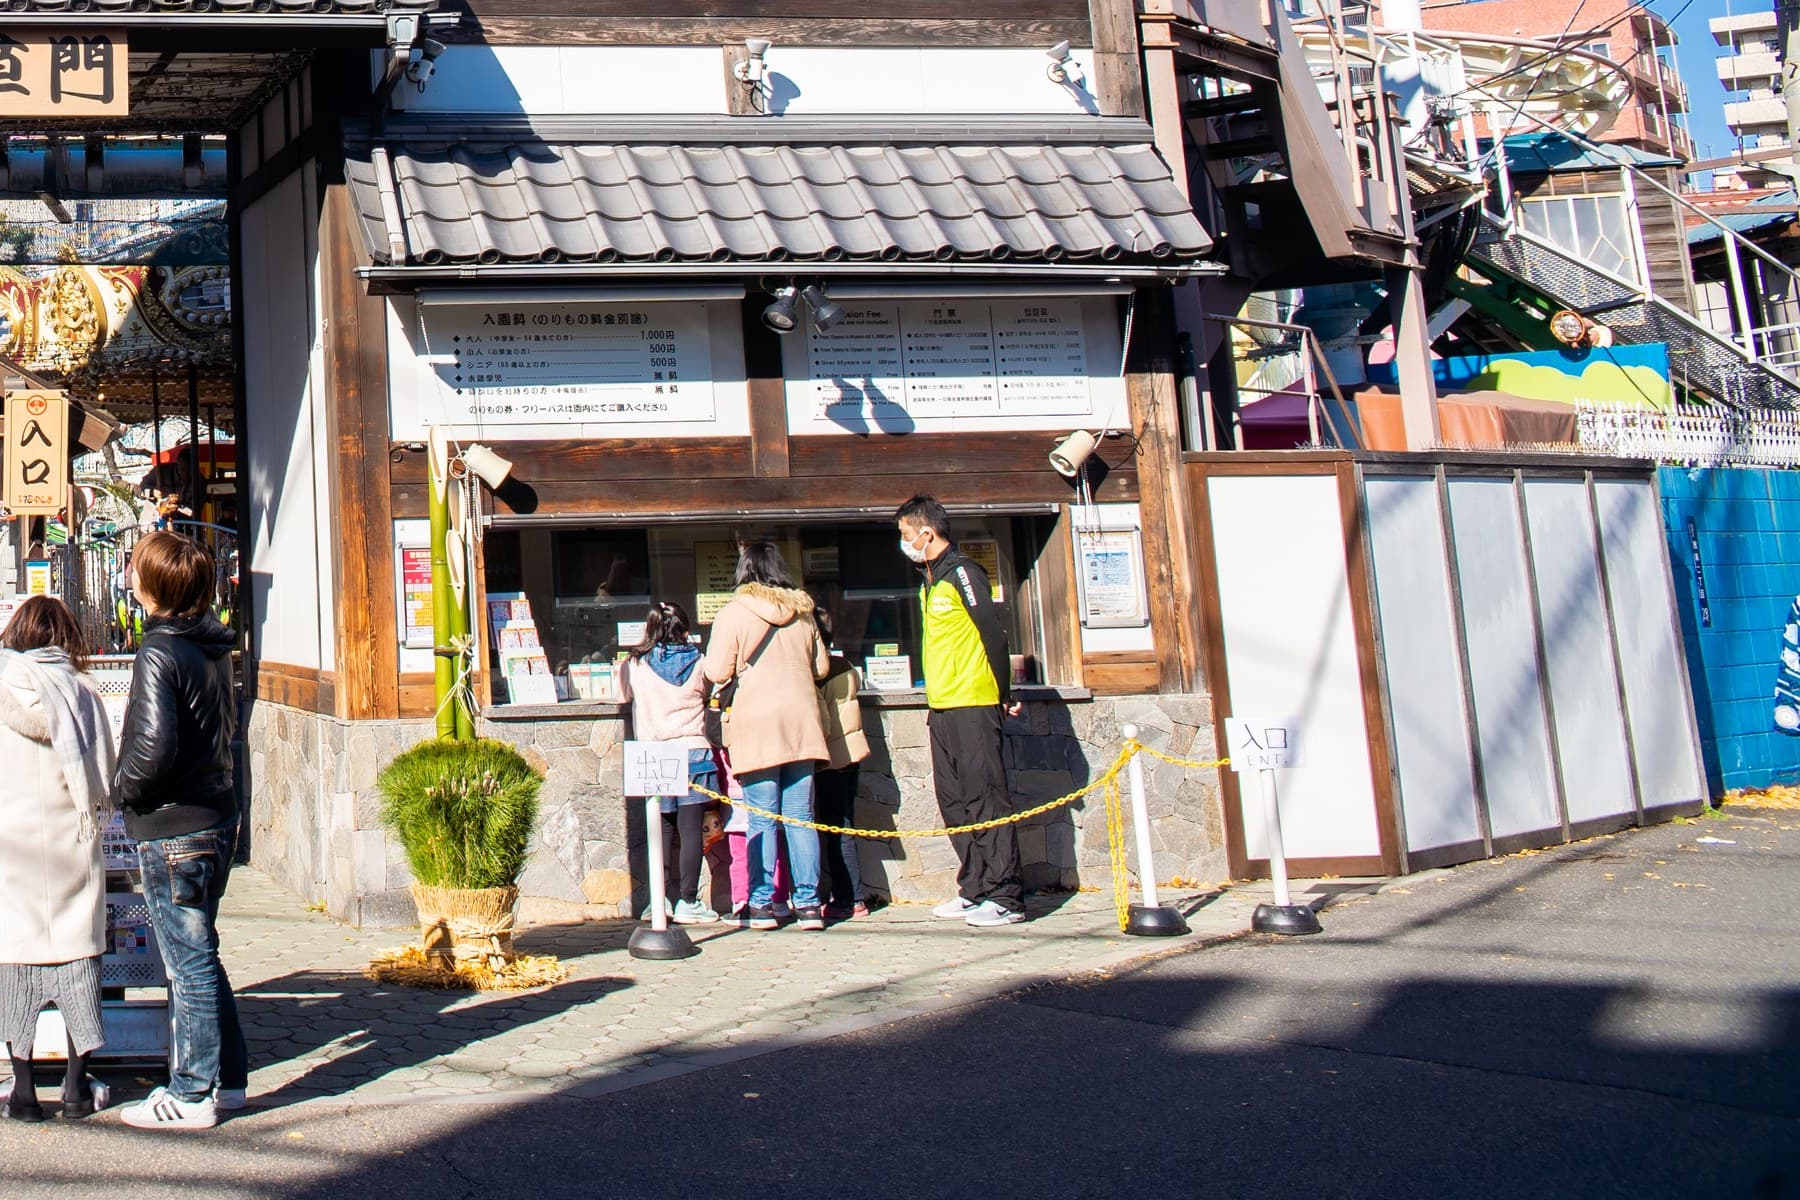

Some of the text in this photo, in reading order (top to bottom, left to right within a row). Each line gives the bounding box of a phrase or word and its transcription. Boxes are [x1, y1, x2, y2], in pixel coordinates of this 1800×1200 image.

[867, 310, 881, 318] Fee
[649, 344, 676, 354] 500円
[650, 357, 676, 367] 500円
[20, 419, 52, 485] 入口
[1241, 724, 1288, 750] 入口
[637, 750, 681, 781] 出口
